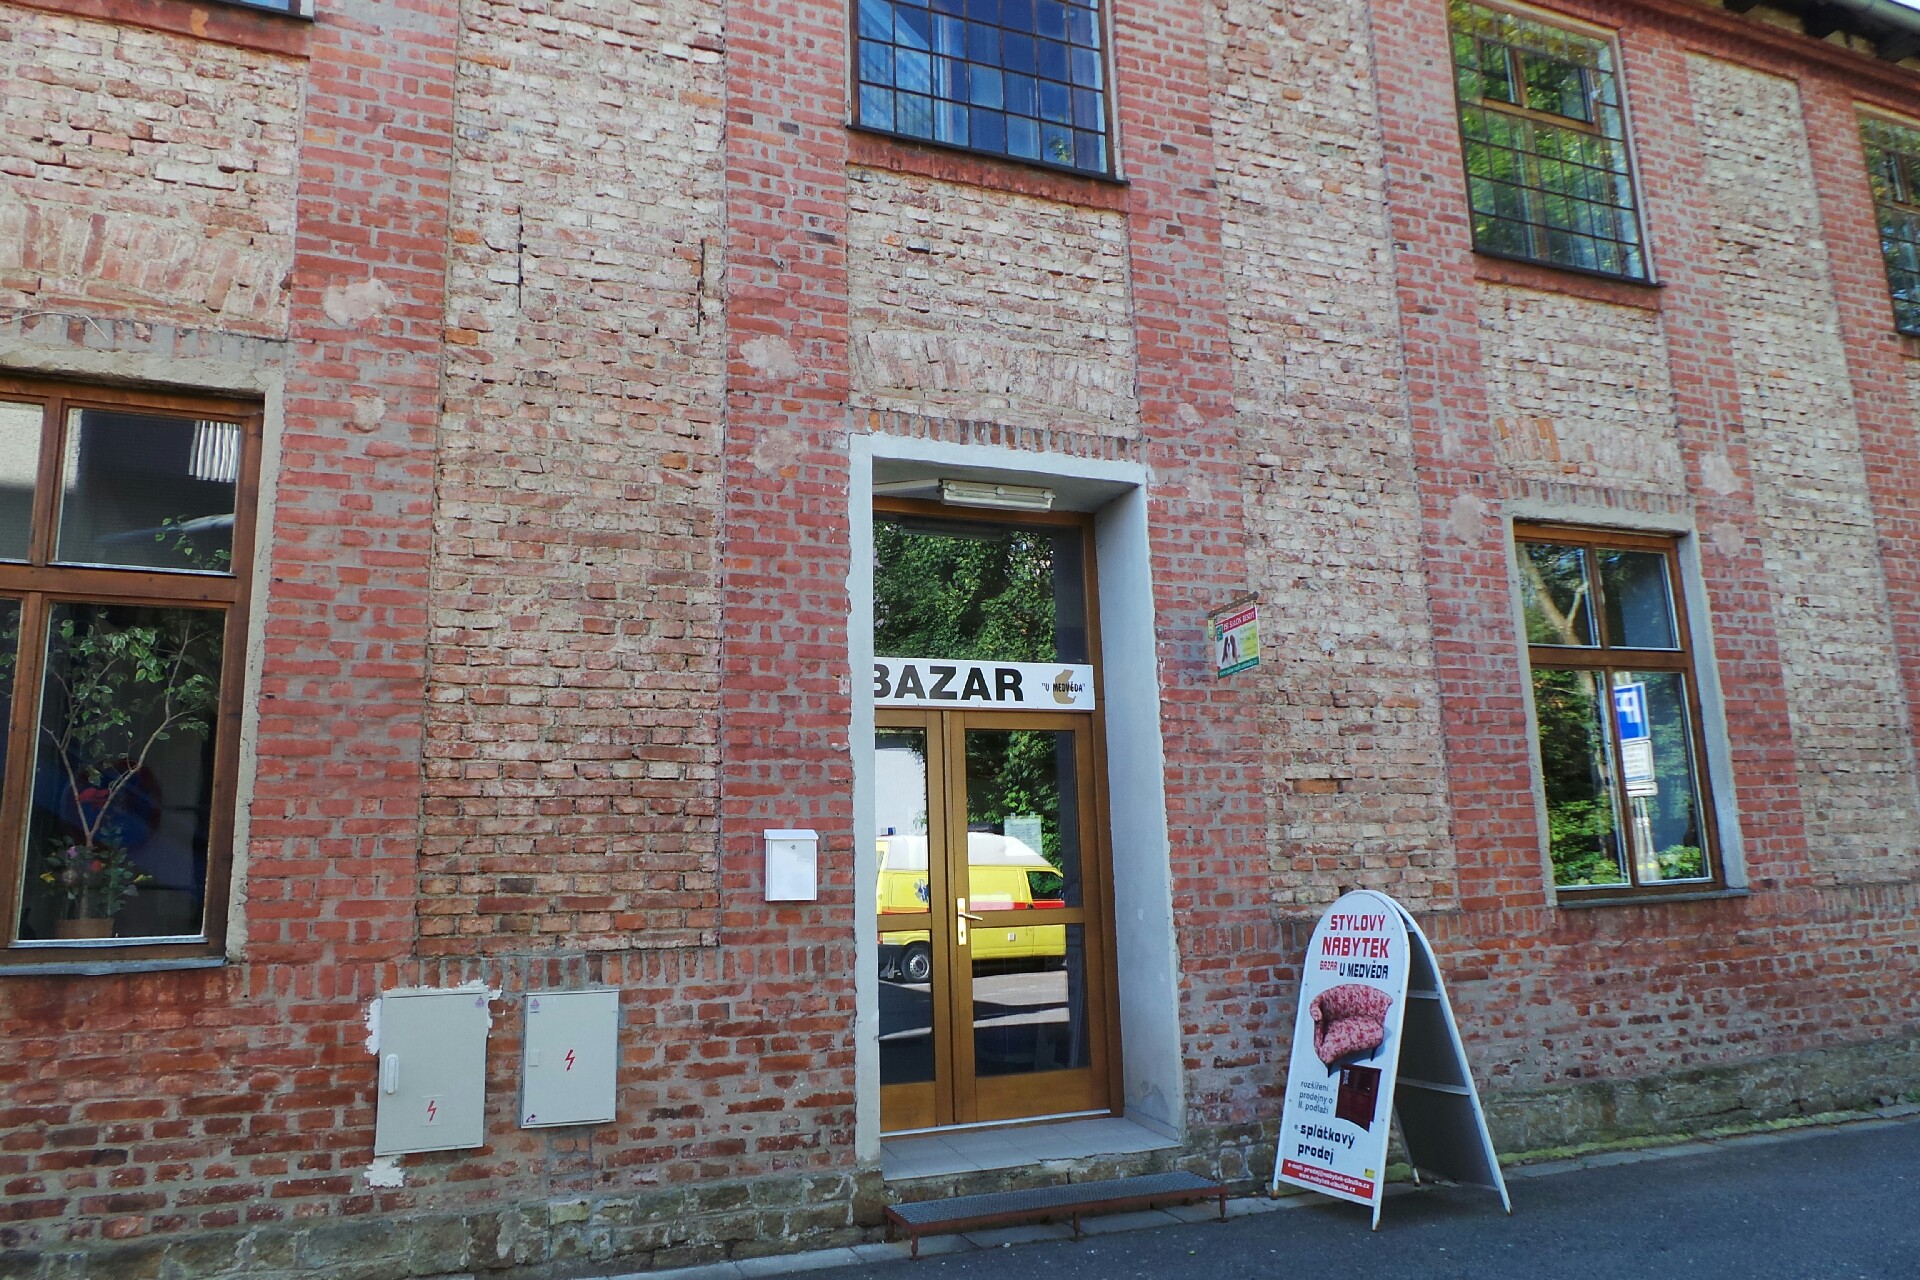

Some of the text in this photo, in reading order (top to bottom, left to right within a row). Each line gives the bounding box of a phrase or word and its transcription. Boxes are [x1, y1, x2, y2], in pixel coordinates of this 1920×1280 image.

[874, 663, 1024, 702] BAZAR
[1321, 932, 1391, 958] NÁBYTEK
[1339, 963, 1346, 976] U
[1346, 960, 1389, 979] MEDVĚDA
[1299, 1091, 1333, 1105] prodejny o
[1300, 1123, 1355, 1150] splátkový
[1297, 1142, 1334, 1165] prodej
